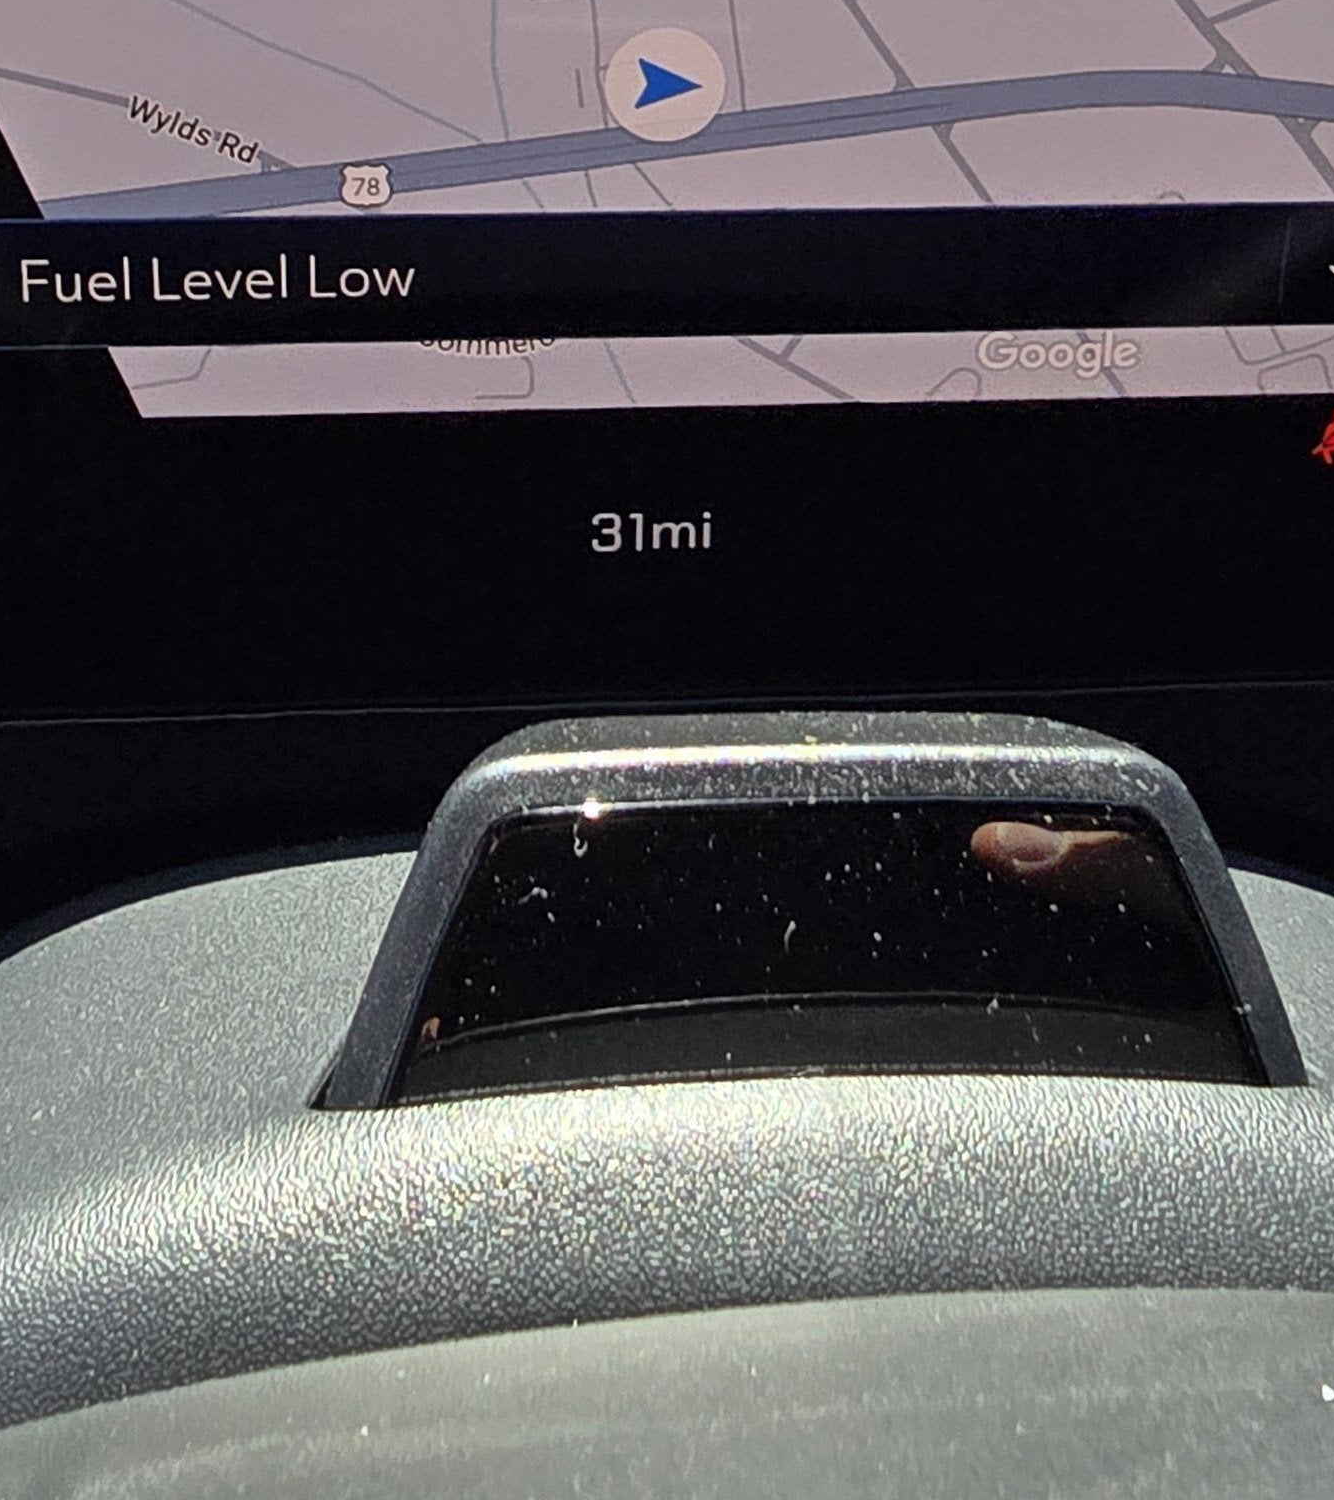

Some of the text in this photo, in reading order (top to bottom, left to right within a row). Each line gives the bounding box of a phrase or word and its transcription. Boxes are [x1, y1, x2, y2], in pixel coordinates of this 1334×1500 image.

[129, 95, 259, 164] Wylds Rd
[351, 177, 381, 197] 78
[20, 252, 416, 303] Fuel Level Low
[419, 338, 555, 356] ommer
[977, 330, 1139, 378] Google
[591, 511, 712, 552] 31mi
